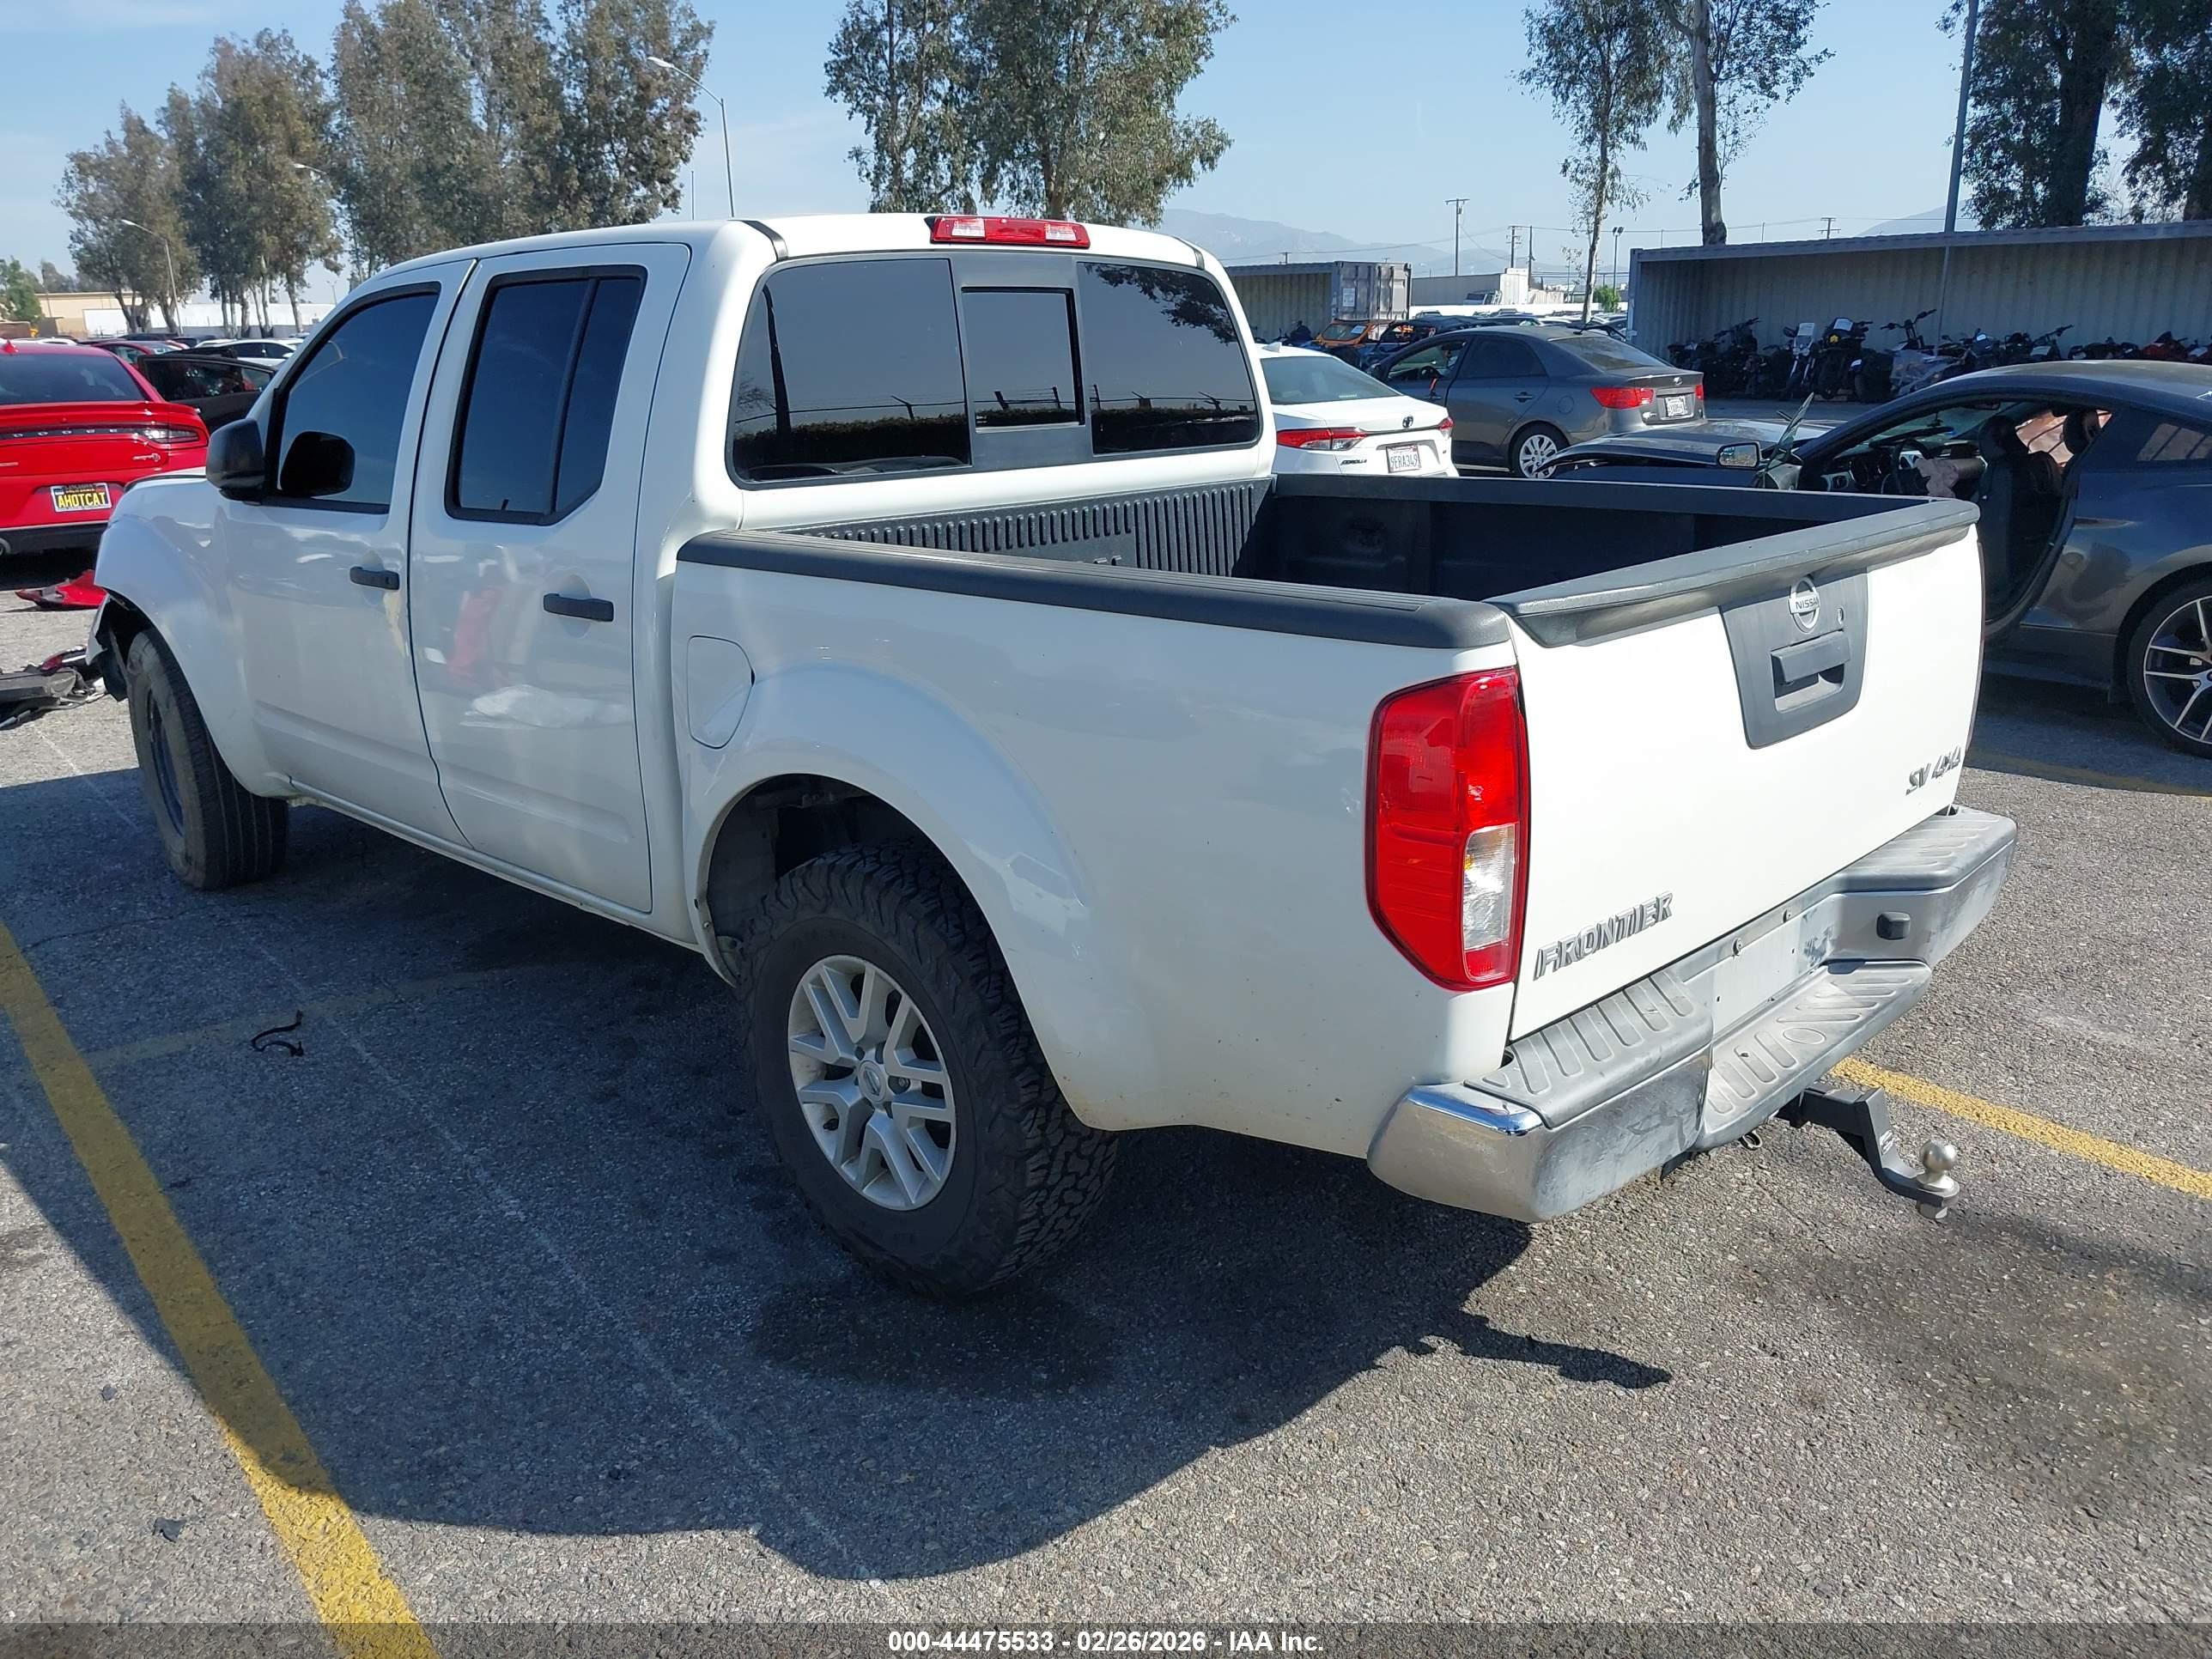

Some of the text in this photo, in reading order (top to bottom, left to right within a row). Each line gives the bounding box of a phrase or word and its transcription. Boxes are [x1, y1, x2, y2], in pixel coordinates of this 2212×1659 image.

[58, 492, 106, 508] AHOTCAT
[1905, 763, 1931, 796] SV
[1533, 890, 1674, 981] FRONTIER
